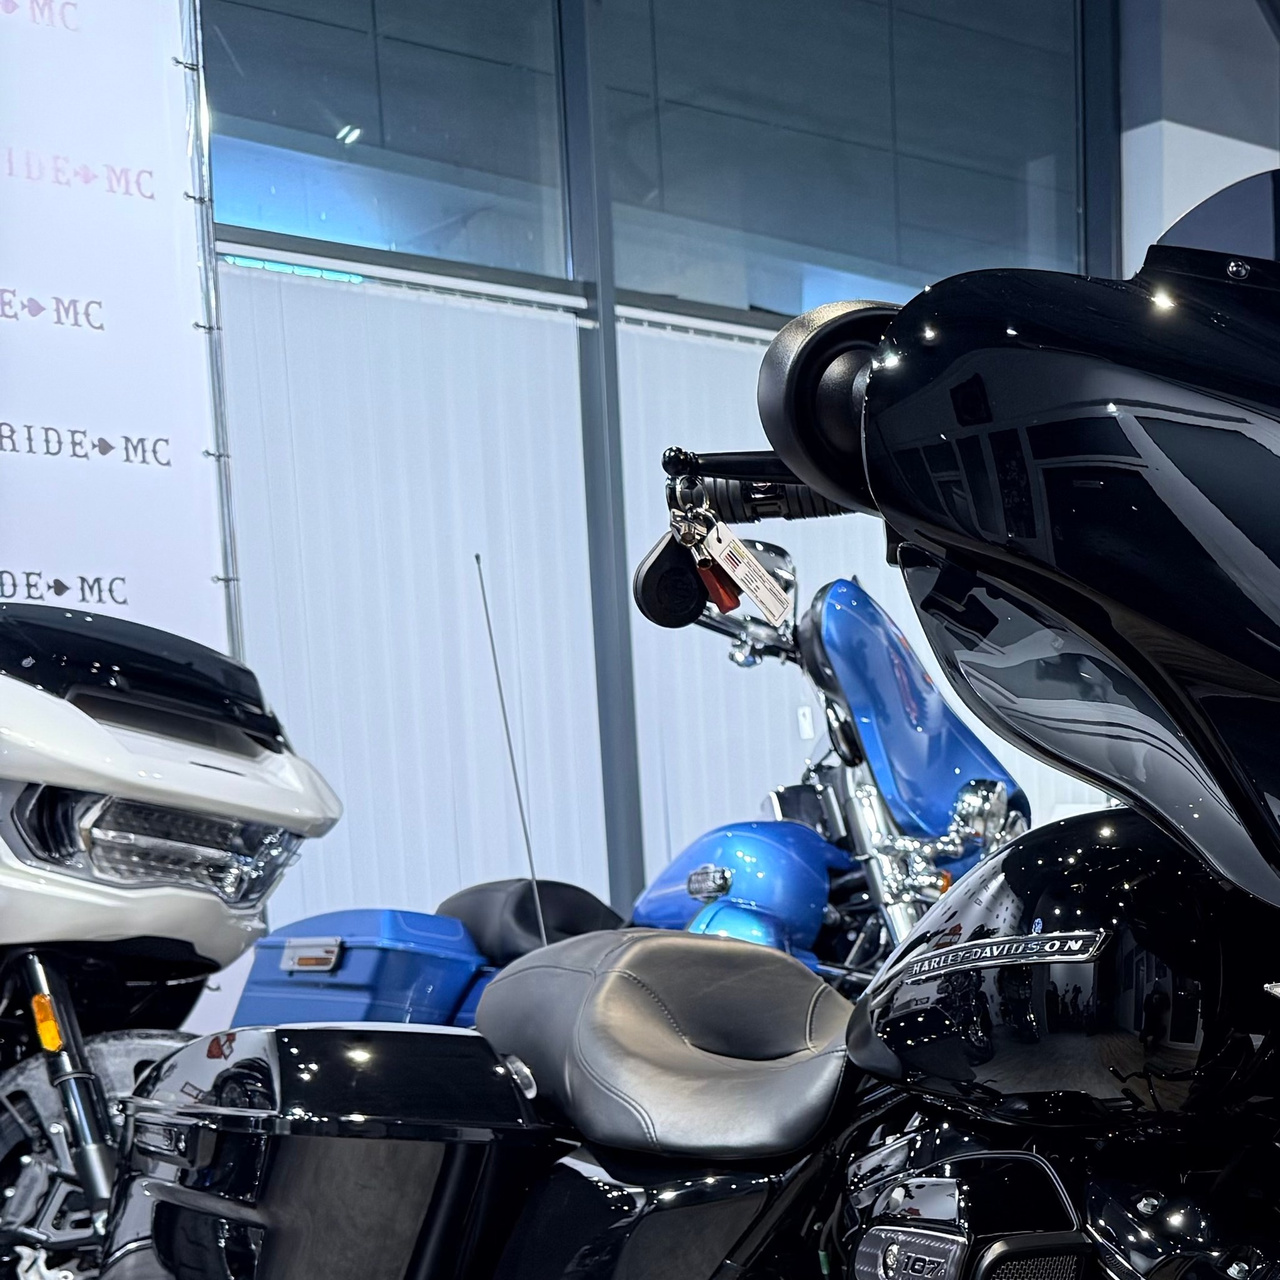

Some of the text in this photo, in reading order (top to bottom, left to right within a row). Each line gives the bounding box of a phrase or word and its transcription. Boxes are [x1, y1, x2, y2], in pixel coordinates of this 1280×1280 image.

[103, 164, 156, 201] MC
[51, 296, 105, 331] MC
[121, 435, 172, 467] MC
[77, 576, 129, 605] MC
[912, 939, 1083, 975] HARLEY-DAVIDSON
